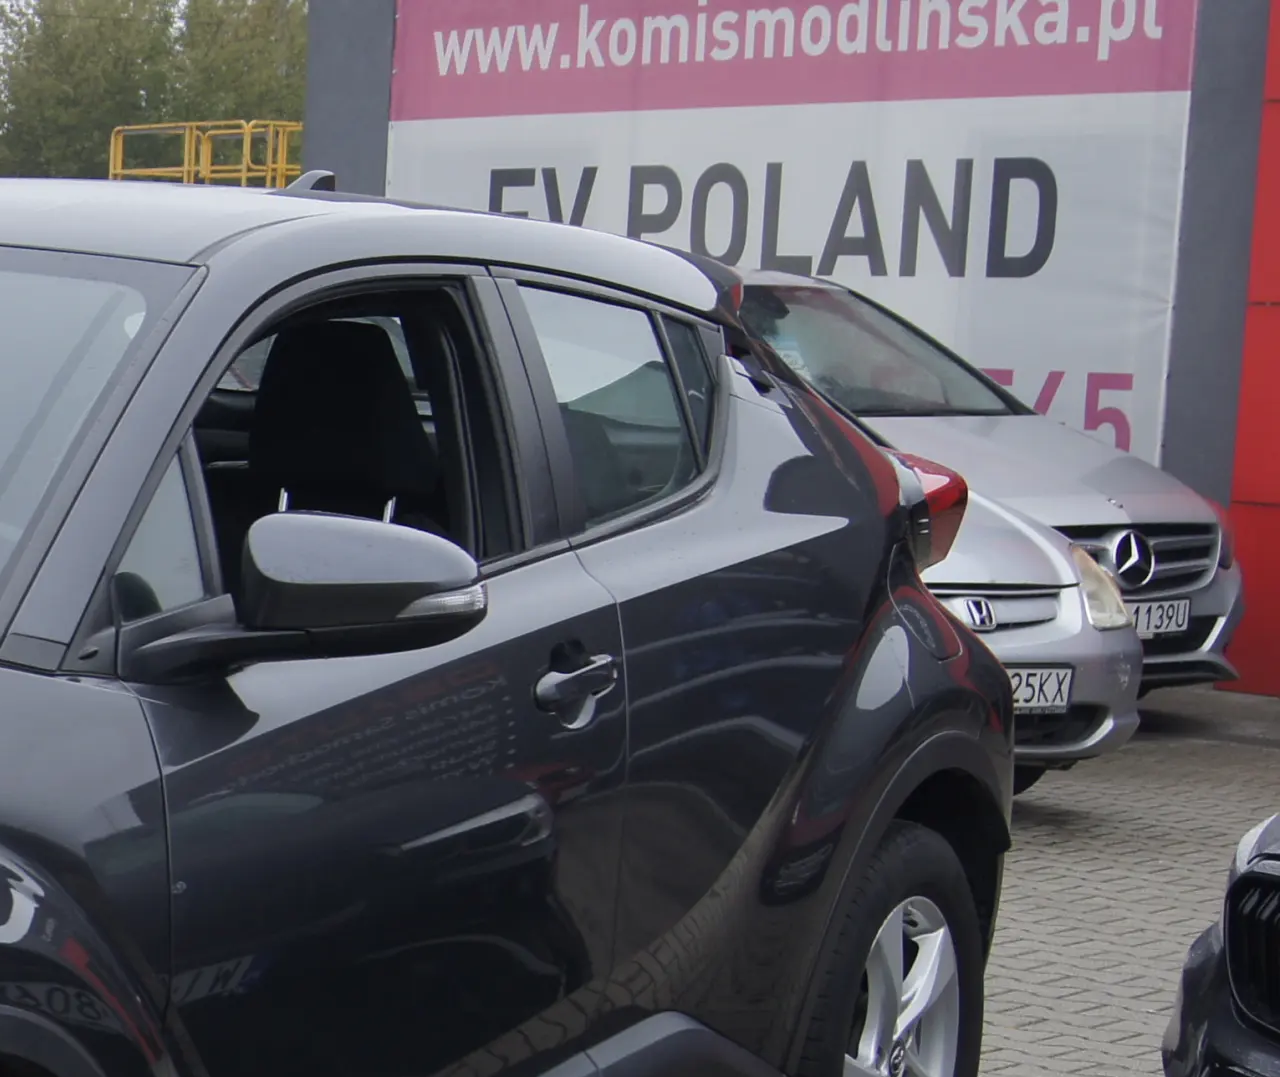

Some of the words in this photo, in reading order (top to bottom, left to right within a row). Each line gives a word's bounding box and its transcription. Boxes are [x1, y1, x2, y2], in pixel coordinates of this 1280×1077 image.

[433, 0, 1164, 77] www.komismodlinska.pl
[626, 156, 1059, 279] POLAND
[1010, 671, 1069, 704] 25KX
